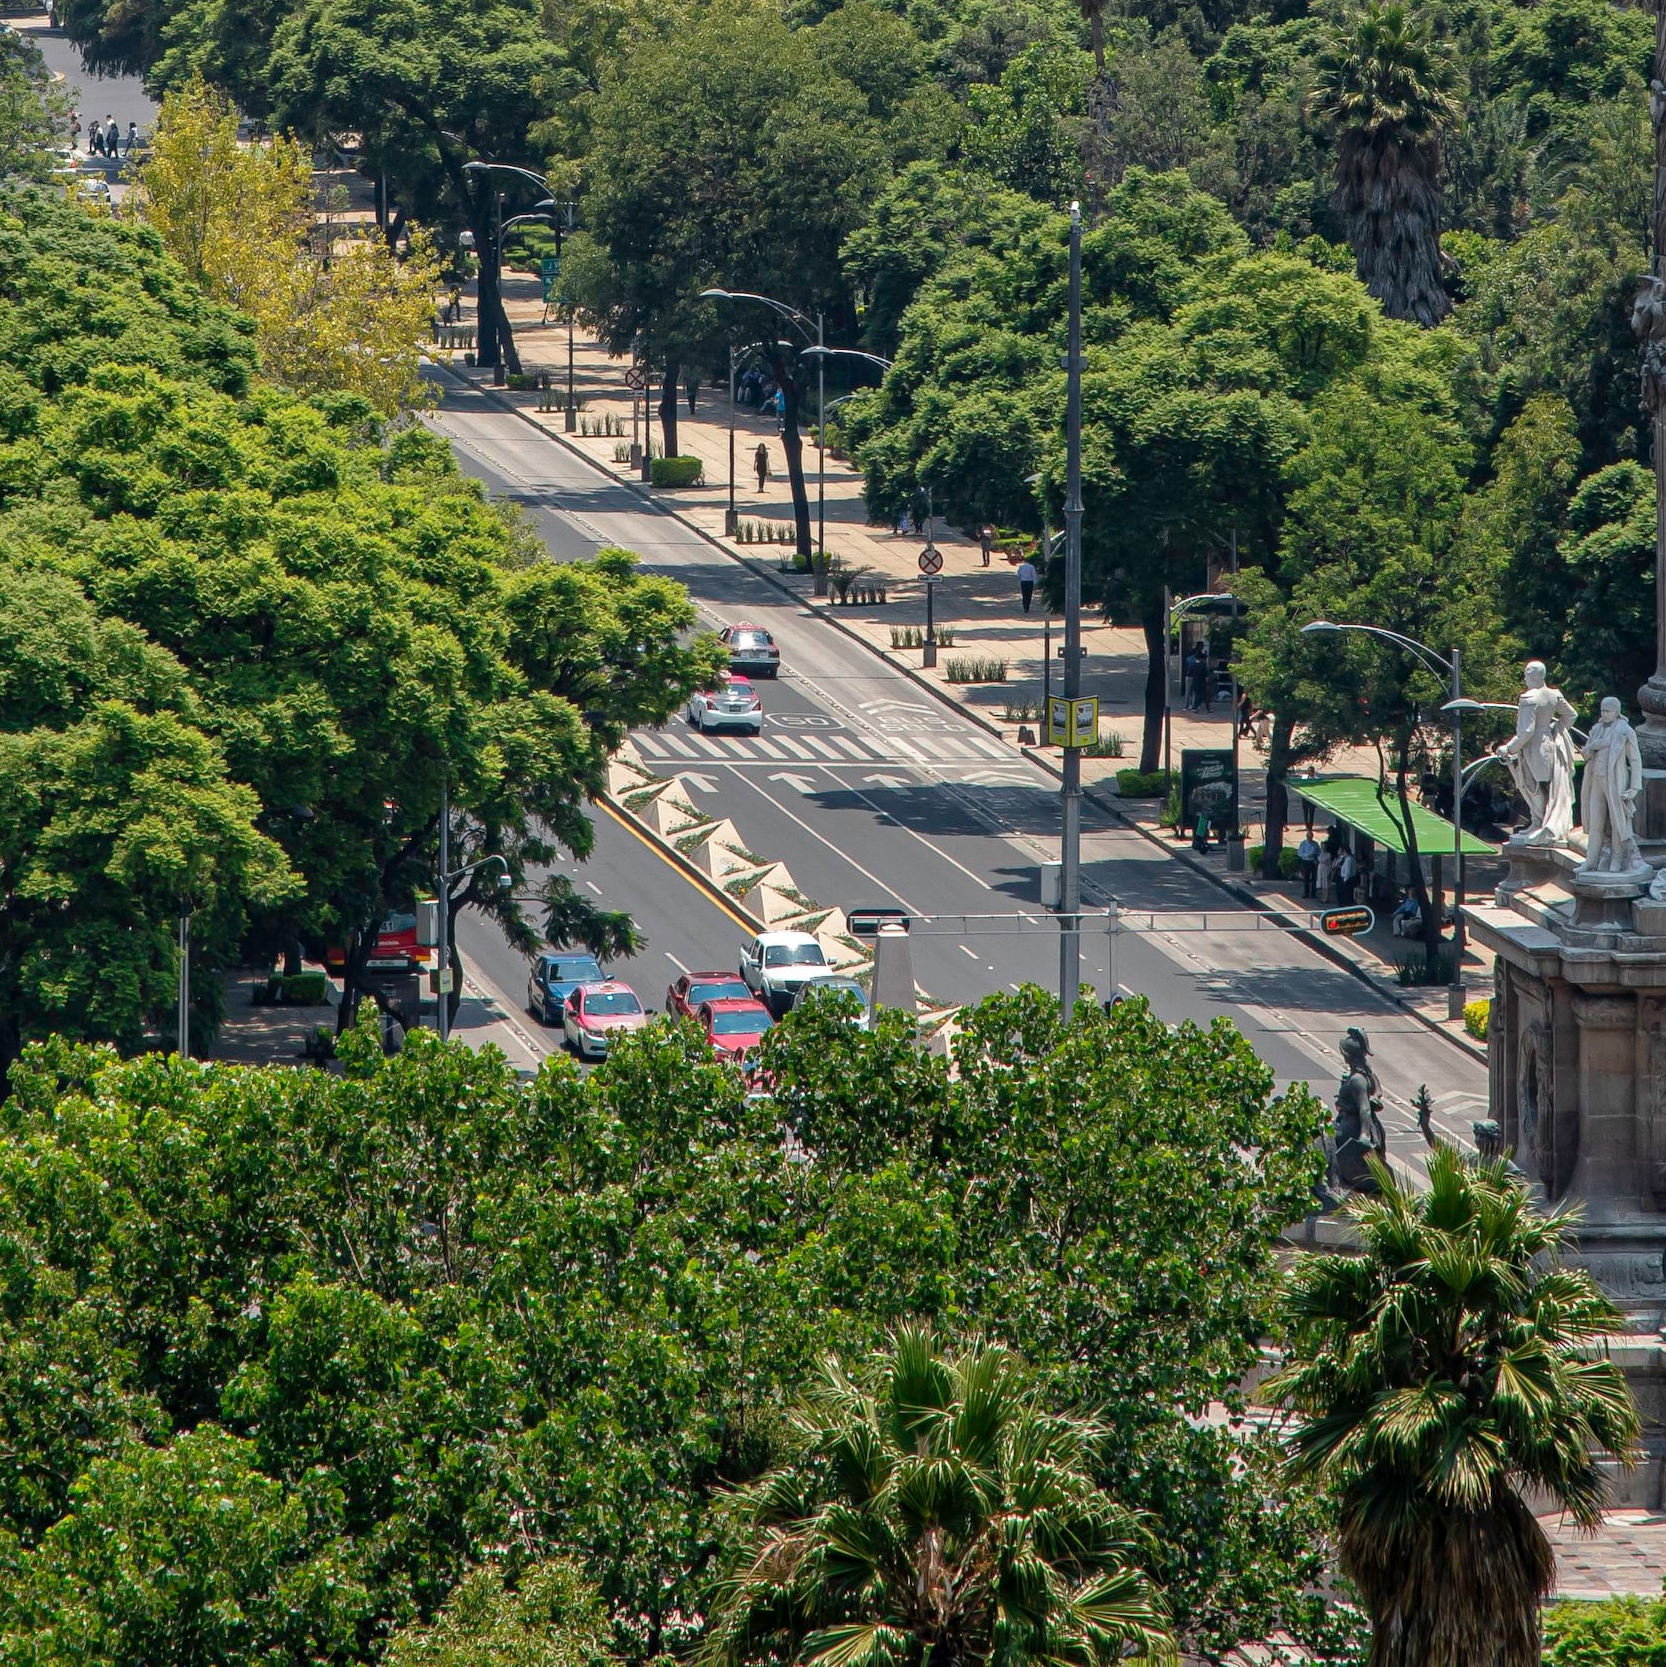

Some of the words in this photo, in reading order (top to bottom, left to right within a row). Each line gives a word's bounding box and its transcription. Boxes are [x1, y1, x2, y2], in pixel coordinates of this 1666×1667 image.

[781, 716, 830, 726] 50
[876, 716, 948, 725] BUS
[879, 724, 970, 733] SOLO
